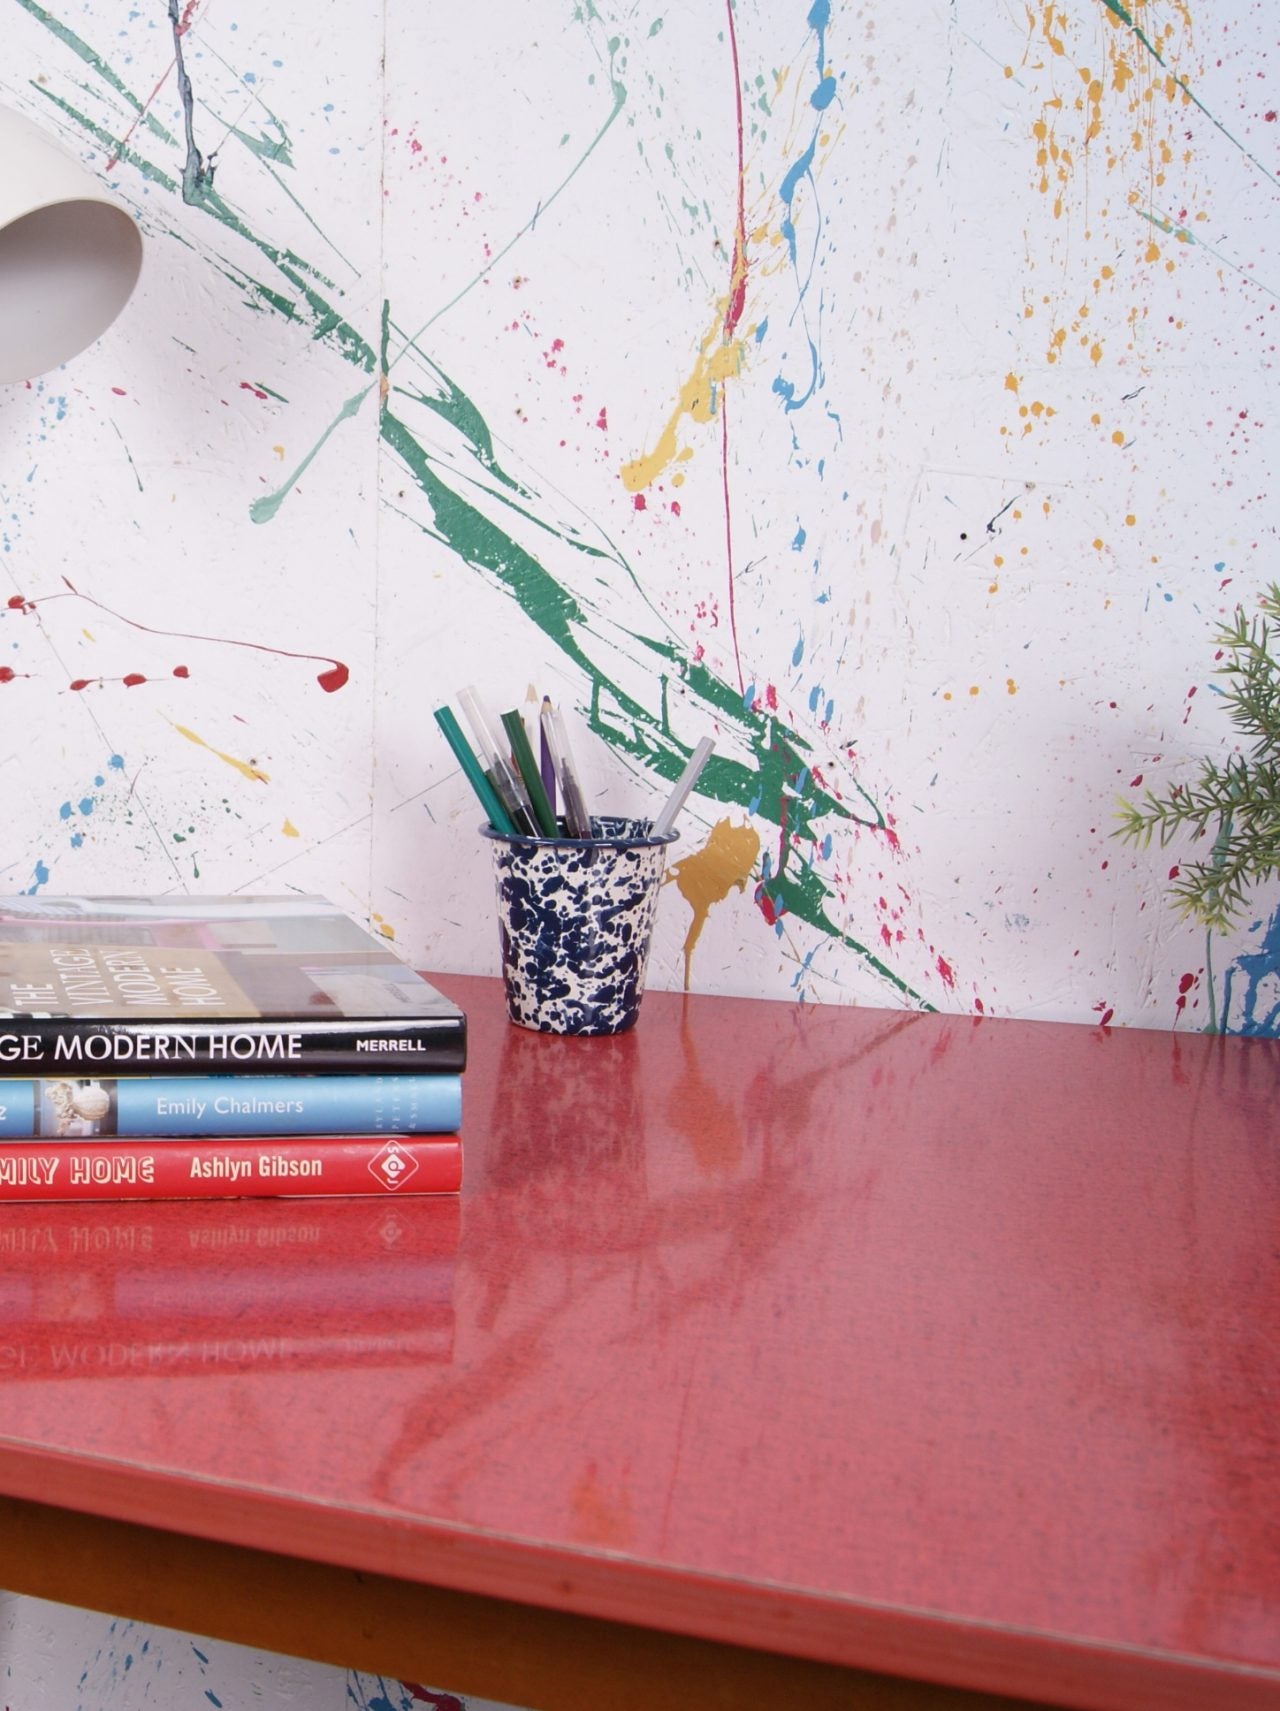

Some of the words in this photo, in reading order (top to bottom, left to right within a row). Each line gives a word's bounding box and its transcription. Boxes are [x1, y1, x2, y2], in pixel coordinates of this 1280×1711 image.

[50, 948, 114, 1006] VINTAGE
[100, 949, 171, 1006] MODERN
[161, 967, 226, 1006] HOME
[10, 983, 59, 1006] THE
[53, 1034, 197, 1061] MODERN
[209, 1033, 302, 1060] HOME
[356, 1039, 426, 1052] MERRELL
[156, 1098, 206, 1120] Emily
[214, 1097, 304, 1115] Chalmers
[392, 1077, 400, 1130] PETES
[410, 1077, 418, 1118] SML
[70, 1155, 155, 1185] HOME
[190, 1156, 252, 1182] Ashlyn
[258, 1155, 323, 1178] Gibson
